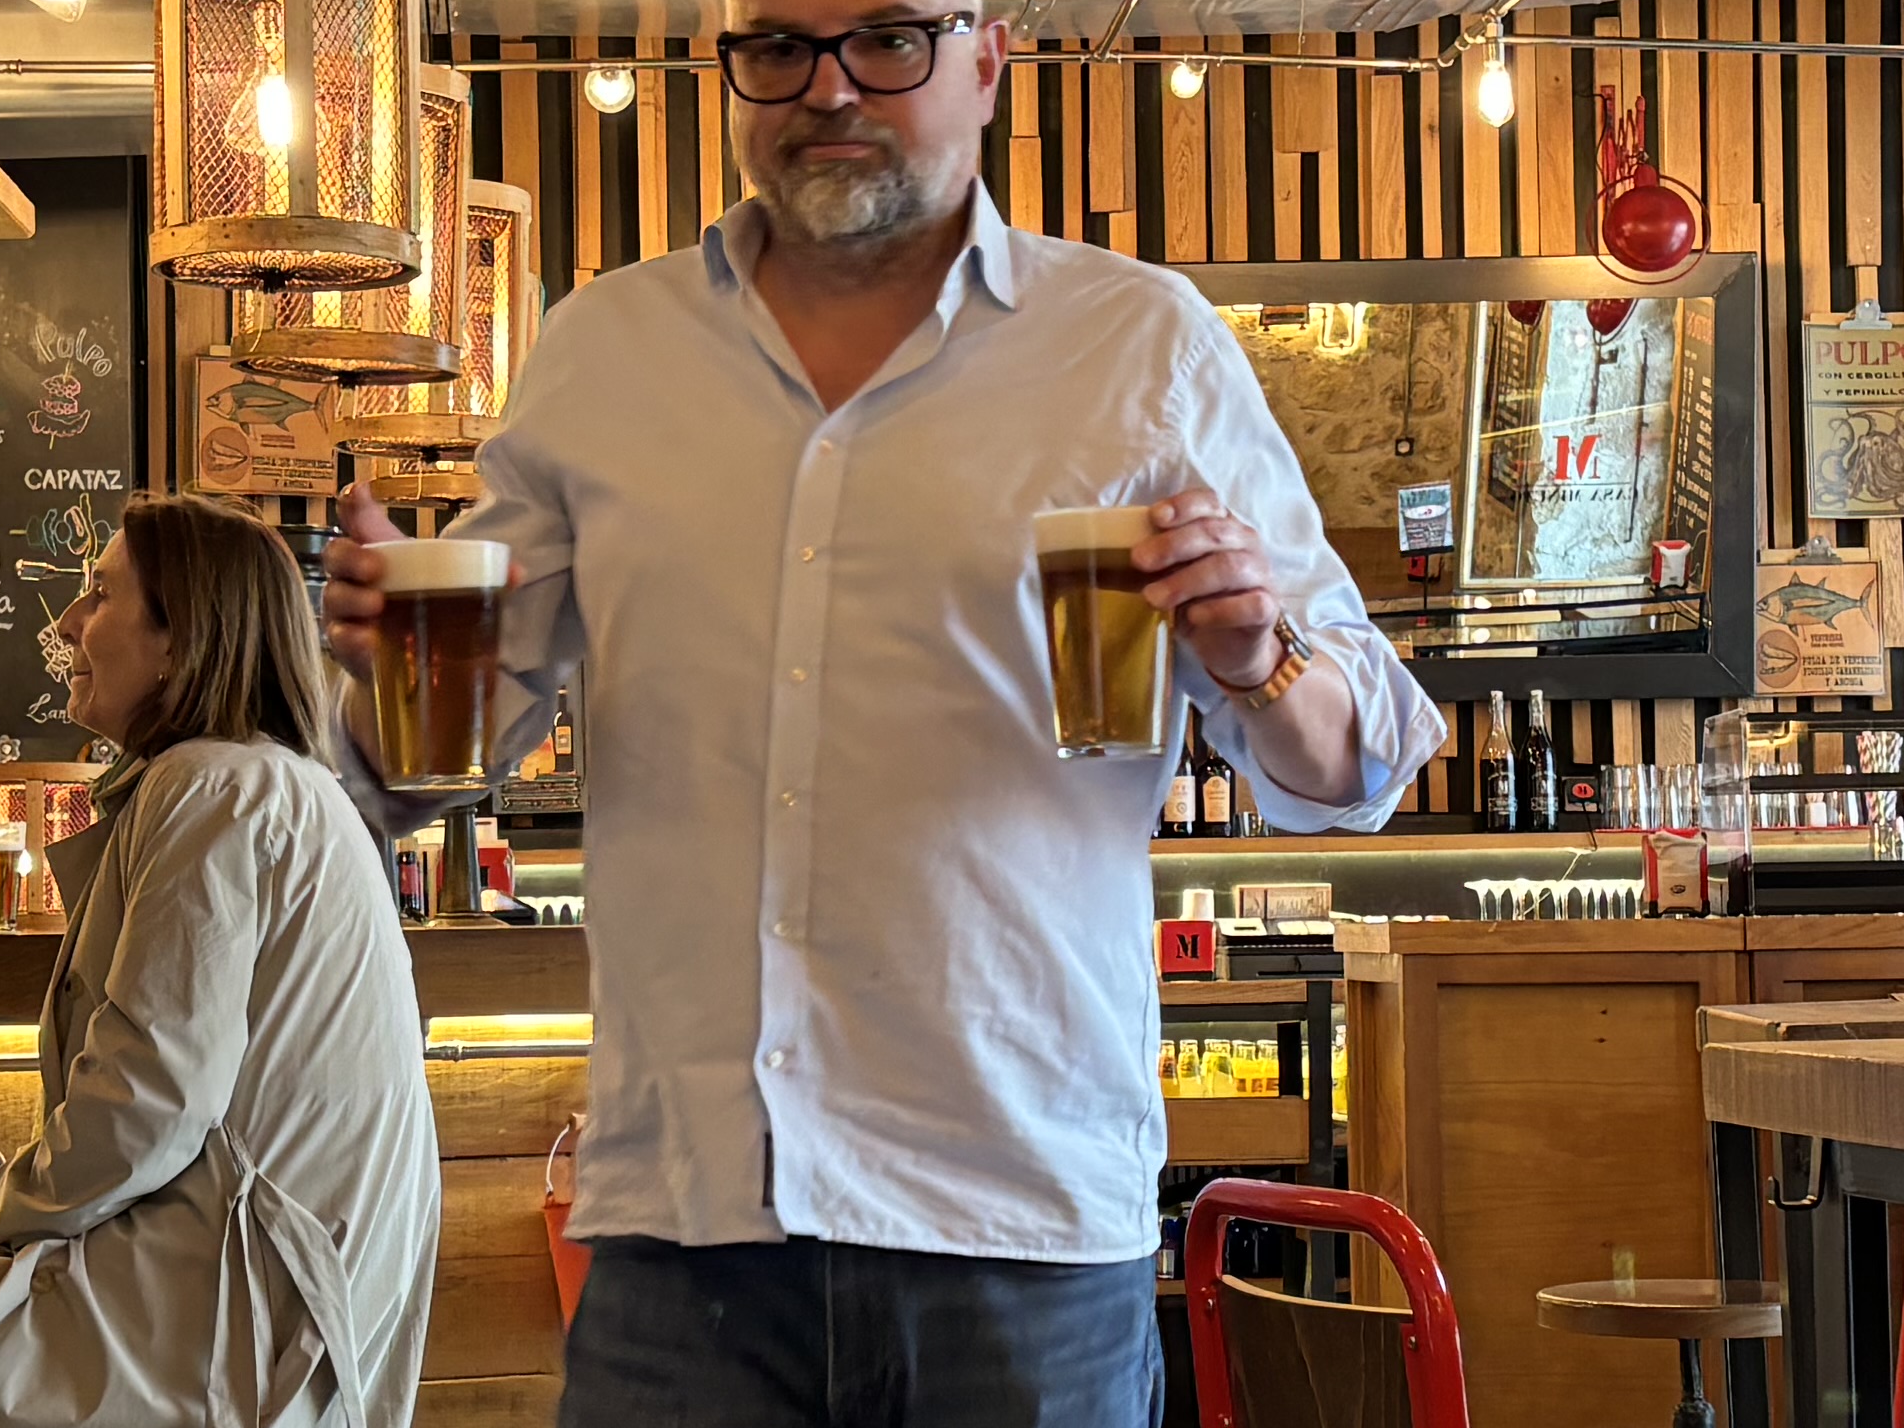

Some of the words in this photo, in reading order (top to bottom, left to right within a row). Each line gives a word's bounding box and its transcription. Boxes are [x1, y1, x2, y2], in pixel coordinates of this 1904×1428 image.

[34, 320, 113, 378] Pulpo
[24, 468, 124, 491] CAPATAZ
[1176, 934, 1200, 960] M
